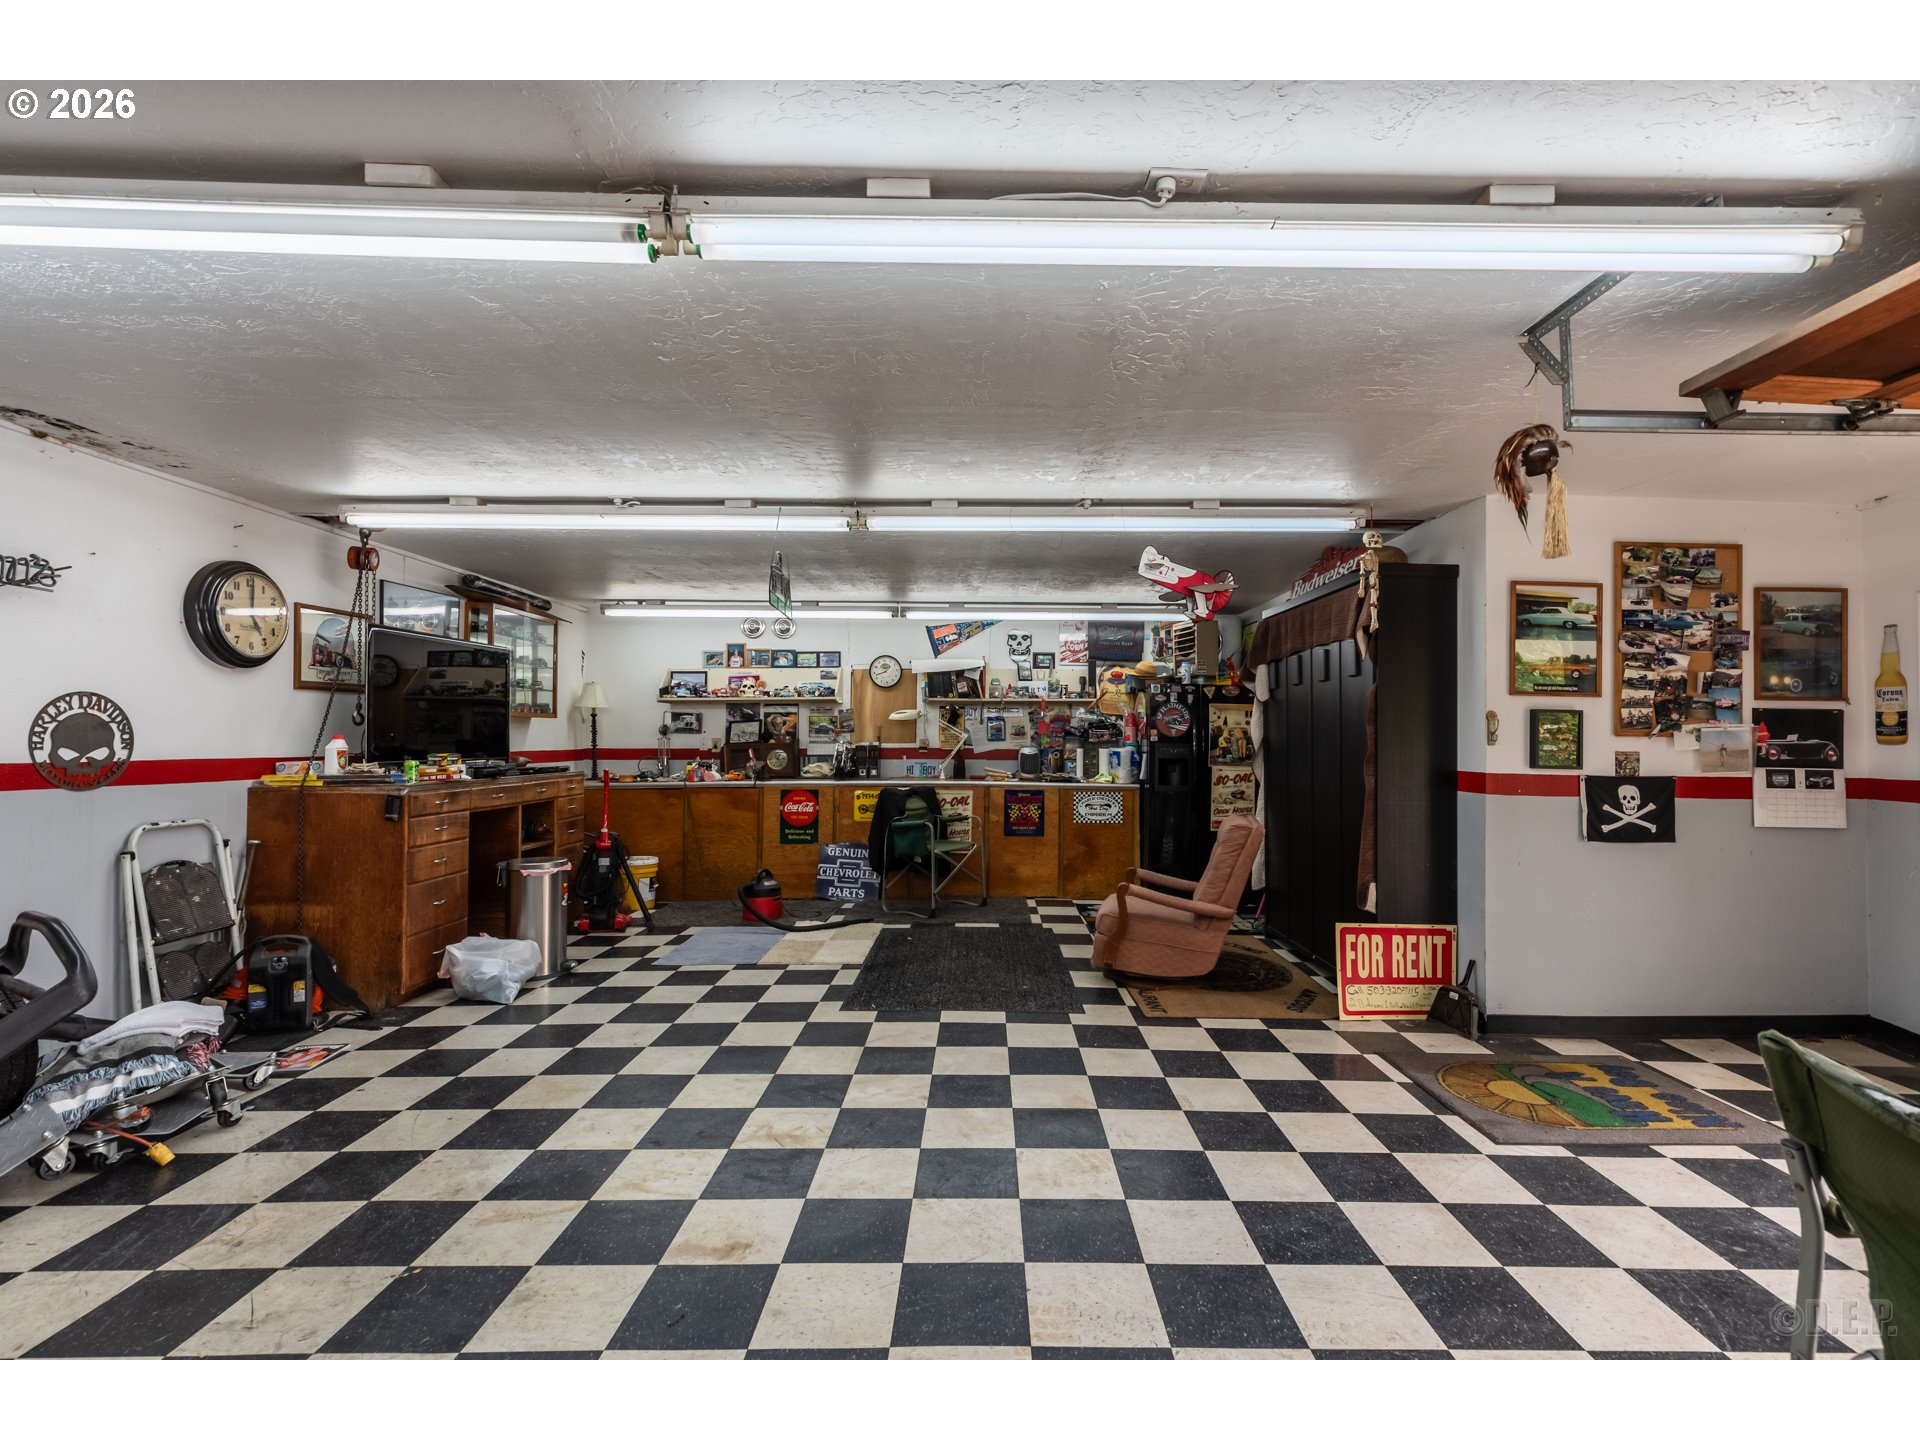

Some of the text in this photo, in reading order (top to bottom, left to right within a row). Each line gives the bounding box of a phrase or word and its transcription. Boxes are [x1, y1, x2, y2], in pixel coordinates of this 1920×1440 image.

[1291, 555, 1361, 599] Budweiser
[1876, 689, 1904, 698] Corona
[1160, 702, 1190, 720] FLATHEADS
[31, 694, 131, 751] HARLEY DAVIDSON
[906, 765, 914, 775] HI
[1213, 807, 1231, 816] OPEN
[827, 847, 869, 858] GENUIN
[819, 867, 877, 880] CHEVROLET
[828, 886, 865, 899] PARTS
[1345, 933, 1447, 979] FOR RENT
[1346, 985, 1364, 996] Call
